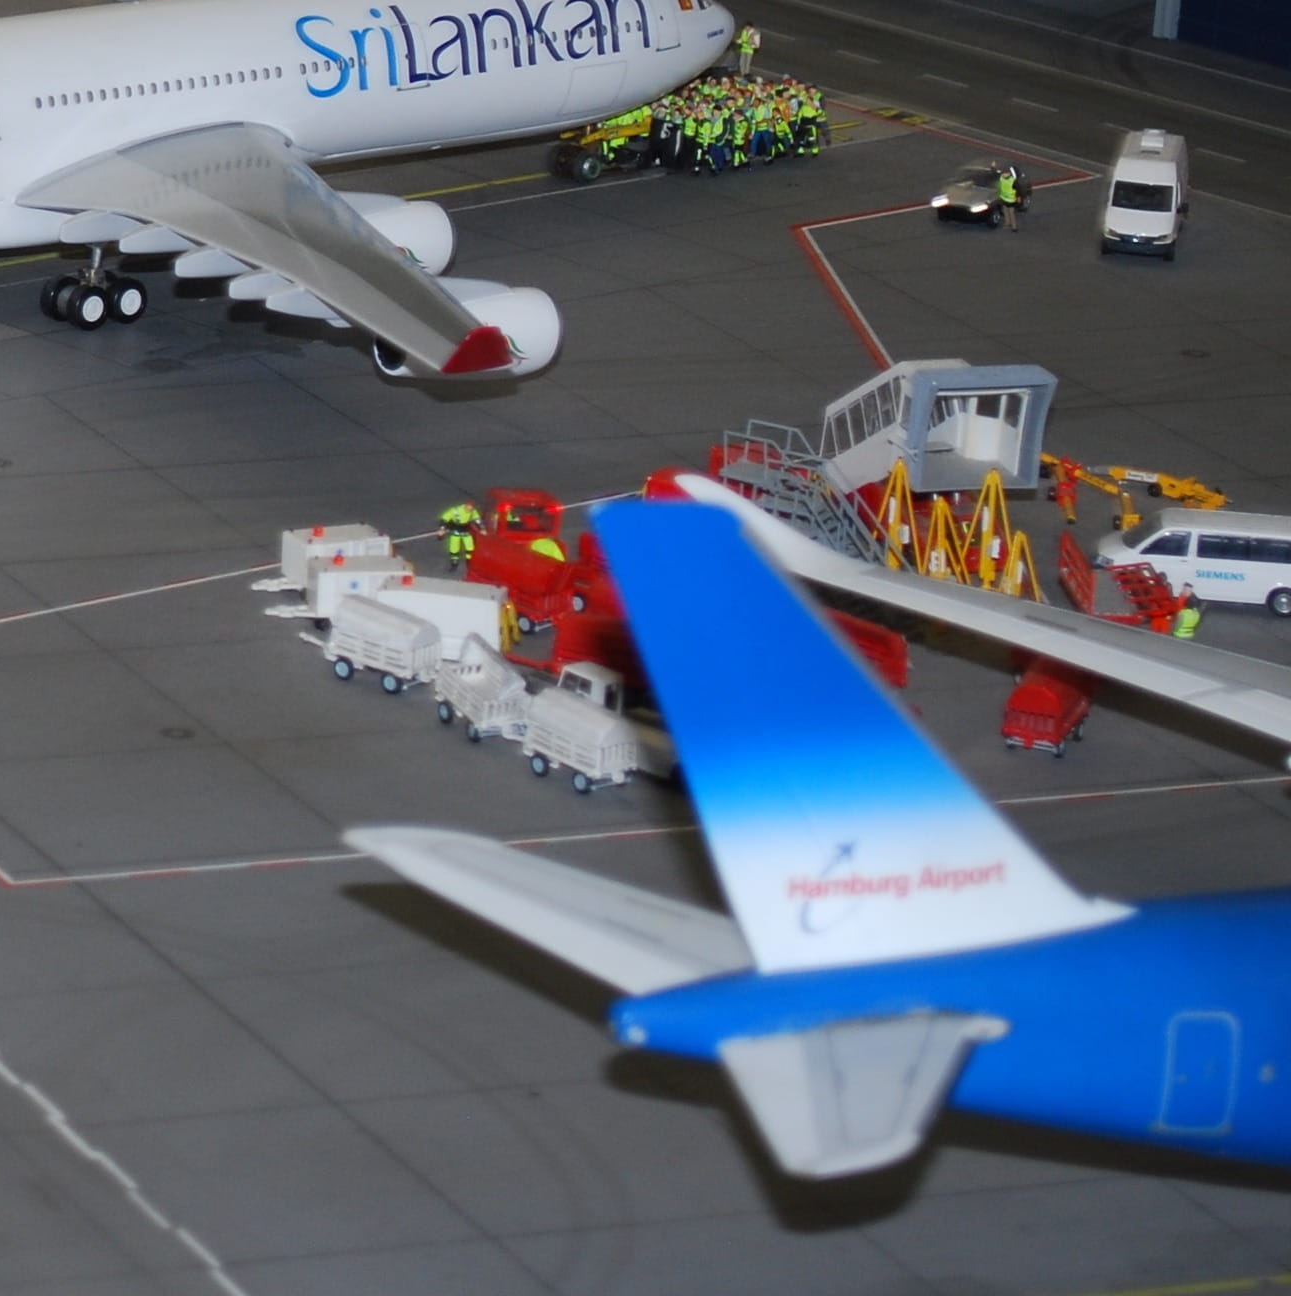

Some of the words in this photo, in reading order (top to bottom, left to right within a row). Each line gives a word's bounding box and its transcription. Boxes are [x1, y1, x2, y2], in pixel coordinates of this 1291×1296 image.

[1195, 568, 1246, 583] SIEMENS
[787, 872, 910, 900] Hamburg
[918, 861, 1006, 893] Airport
